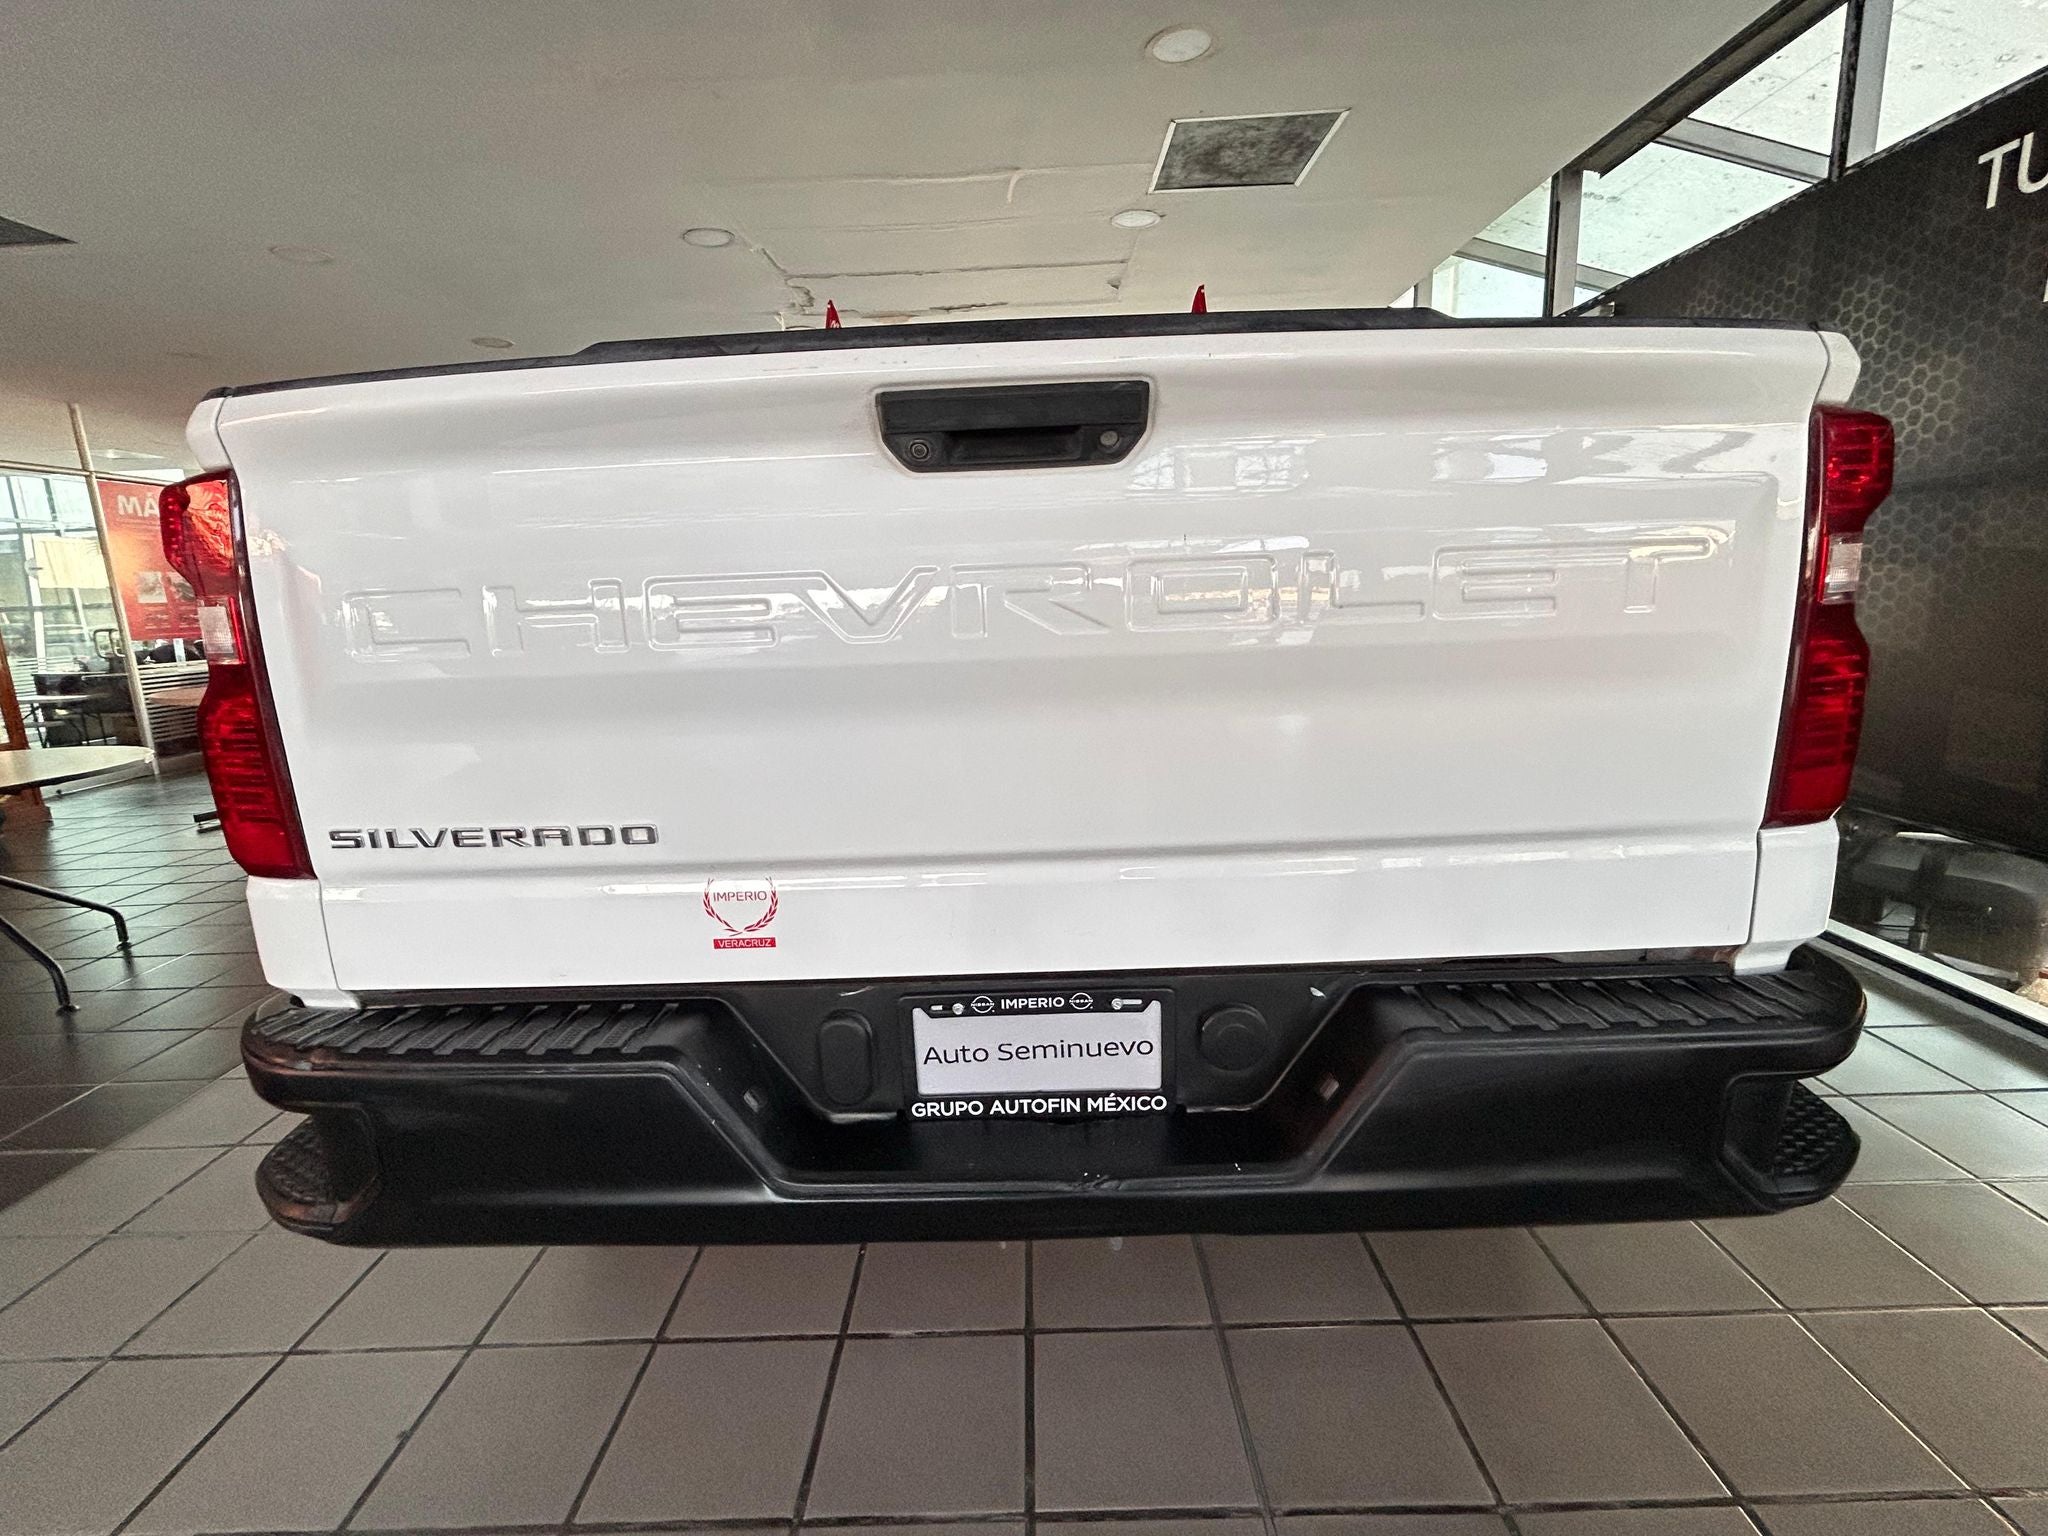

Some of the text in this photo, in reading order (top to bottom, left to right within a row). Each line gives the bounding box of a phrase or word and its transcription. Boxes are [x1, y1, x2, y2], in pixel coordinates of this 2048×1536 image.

[342, 535, 1716, 658] CHEVROLET
[328, 823, 659, 849] SILVERADO
[713, 890, 767, 902] IMPERIO
[718, 938, 771, 948] VERACRUZ
[1001, 997, 1065, 1009] IMPERIO
[923, 1039, 1154, 1065] Auto Seminuevo
[911, 1093, 1168, 1117] GRUPO AUTOFIN MÉXICO
